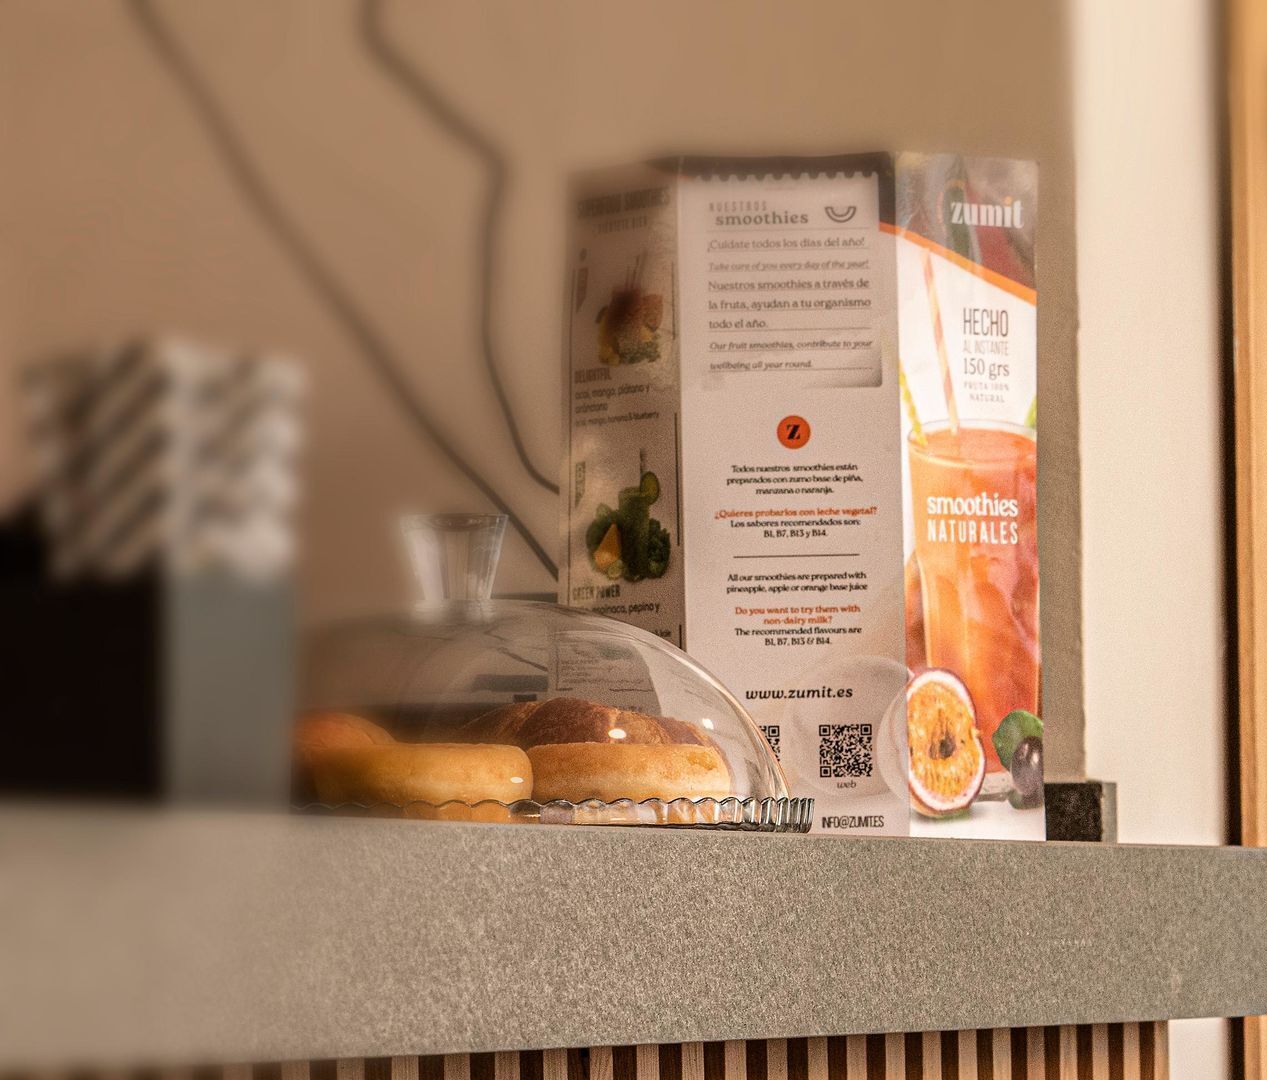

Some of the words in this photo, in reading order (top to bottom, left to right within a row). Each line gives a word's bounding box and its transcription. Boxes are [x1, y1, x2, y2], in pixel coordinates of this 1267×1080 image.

[951, 196, 1024, 228] zumit
[715, 211, 809, 226] smoothies
[752, 240, 781, 249] todos
[783, 239, 798, 248] los
[824, 237, 839, 247] del
[708, 279, 755, 290] Nuestros
[757, 278, 813, 289] smoothies
[822, 278, 854, 288] través
[856, 277, 869, 288] de
[708, 300, 718, 310] la
[720, 299, 749, 310] fruta,
[751, 299, 790, 310] ayudan
[800, 299, 812, 308] tu
[813, 298, 871, 310] organismo
[709, 319, 732, 329] todo
[734, 319, 744, 328] el
[963, 308, 1009, 337] HECHO
[796, 339, 841, 349] contribute
[963, 358, 985, 375] 150
[988, 360, 1010, 380] grs
[785, 423, 802, 441] Z
[732, 464, 755, 473] Todos
[756, 465, 790, 473] nuestros
[793, 463, 835, 472] smoothies
[726, 476, 772, 486] preparados
[772, 476, 788, 484] con
[813, 474, 831, 483] base
[832, 474, 842, 482] de
[756, 487, 794, 495] manzana
[927, 491, 1019, 517] smoothies
[755, 508, 797, 519] probarlos
[817, 507, 839, 516] leche
[731, 520, 745, 528] Los
[746, 519, 779, 527] sabores
[780, 518, 842, 527] recomendados
[928, 519, 1018, 545] NATURALES
[727, 573, 738, 582] All
[739, 574, 753, 582] our
[754, 573, 796, 581] smoothies
[797, 573, 810, 581] are
[811, 571, 847, 582] prepared
[848, 571, 866, 580] with
[768, 584, 790, 594] apple
[800, 583, 828, 592] orange
[829, 583, 848, 591] base
[735, 607, 747, 615] Do
[749, 607, 765, 616] you
[766, 606, 789, 614] want
[790, 606, 799, 614] to
[801, 605, 814, 615] try
[815, 605, 839, 613] them
[841, 604, 860, 613] with
[763, 616, 806, 626] non-dairy
[807, 615, 832, 625] milk?
[735, 627, 750, 636] The
[752, 626, 812, 636] recommended
[814, 626, 847, 635] flavours
[745, 686, 853, 700] www.zumit.es
[837, 780, 857, 789] web
